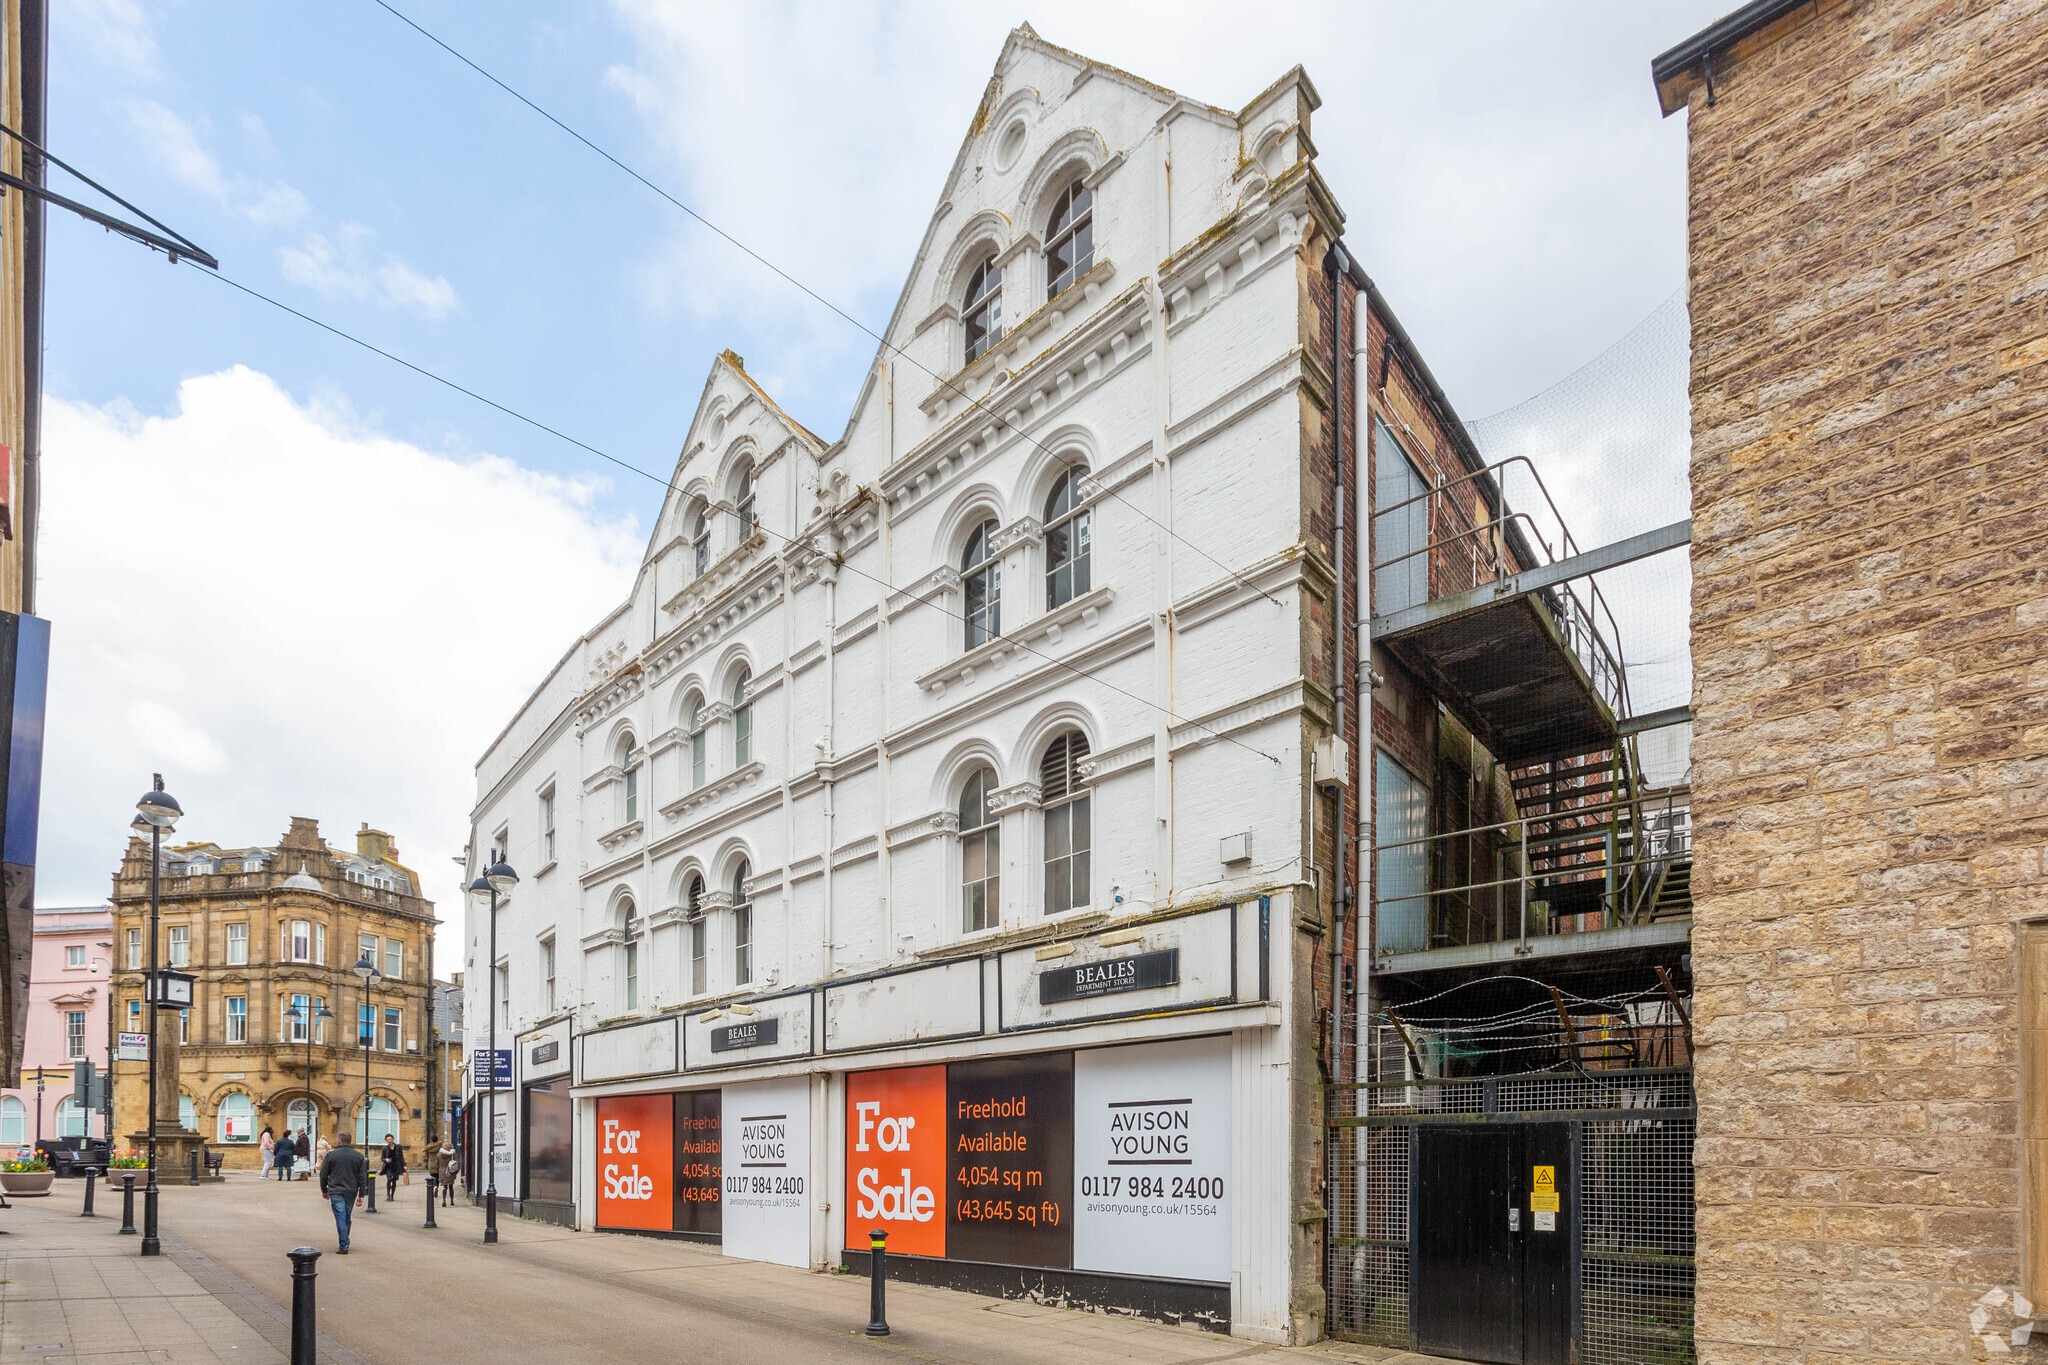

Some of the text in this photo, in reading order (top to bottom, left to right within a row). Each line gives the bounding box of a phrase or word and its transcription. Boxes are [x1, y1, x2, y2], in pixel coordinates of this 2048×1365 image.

[1076, 960, 1135, 984] BEALES
[1076, 977, 1135, 992] DEPARTMENT STORES
[728, 1024, 757, 1040] BEALES
[958, 1096, 1026, 1119] Freehold
[683, 1115, 722, 1130] Freehol
[856, 1101, 916, 1152] For
[1110, 1110, 1188, 1132] AVISON
[603, 1120, 640, 1154] For
[742, 1124, 784, 1140] AVISON
[958, 1131, 1027, 1152] Available
[682, 1140, 722, 1154] Availabl
[742, 1143, 784, 1159] YOUNG
[1110, 1134, 1188, 1154] YOUNG
[682, 1164, 710, 1179] 4,054
[958, 1166, 1042, 1191] 4,054 sq m
[604, 1164, 653, 1200] Sale
[726, 1176, 804, 1194] 0117 984 2400
[1082, 1176, 1224, 1199] 0117 984 2400
[682, 1187, 719, 1203] (43,645
[730, 1198, 800, 1208] avisonyoung.co.uk/15564
[857, 1167, 935, 1222] Sale
[957, 1200, 1060, 1227] (43,645 sq ft)
[1087, 1202, 1217, 1216] avisonyoung.co.uk/15564
